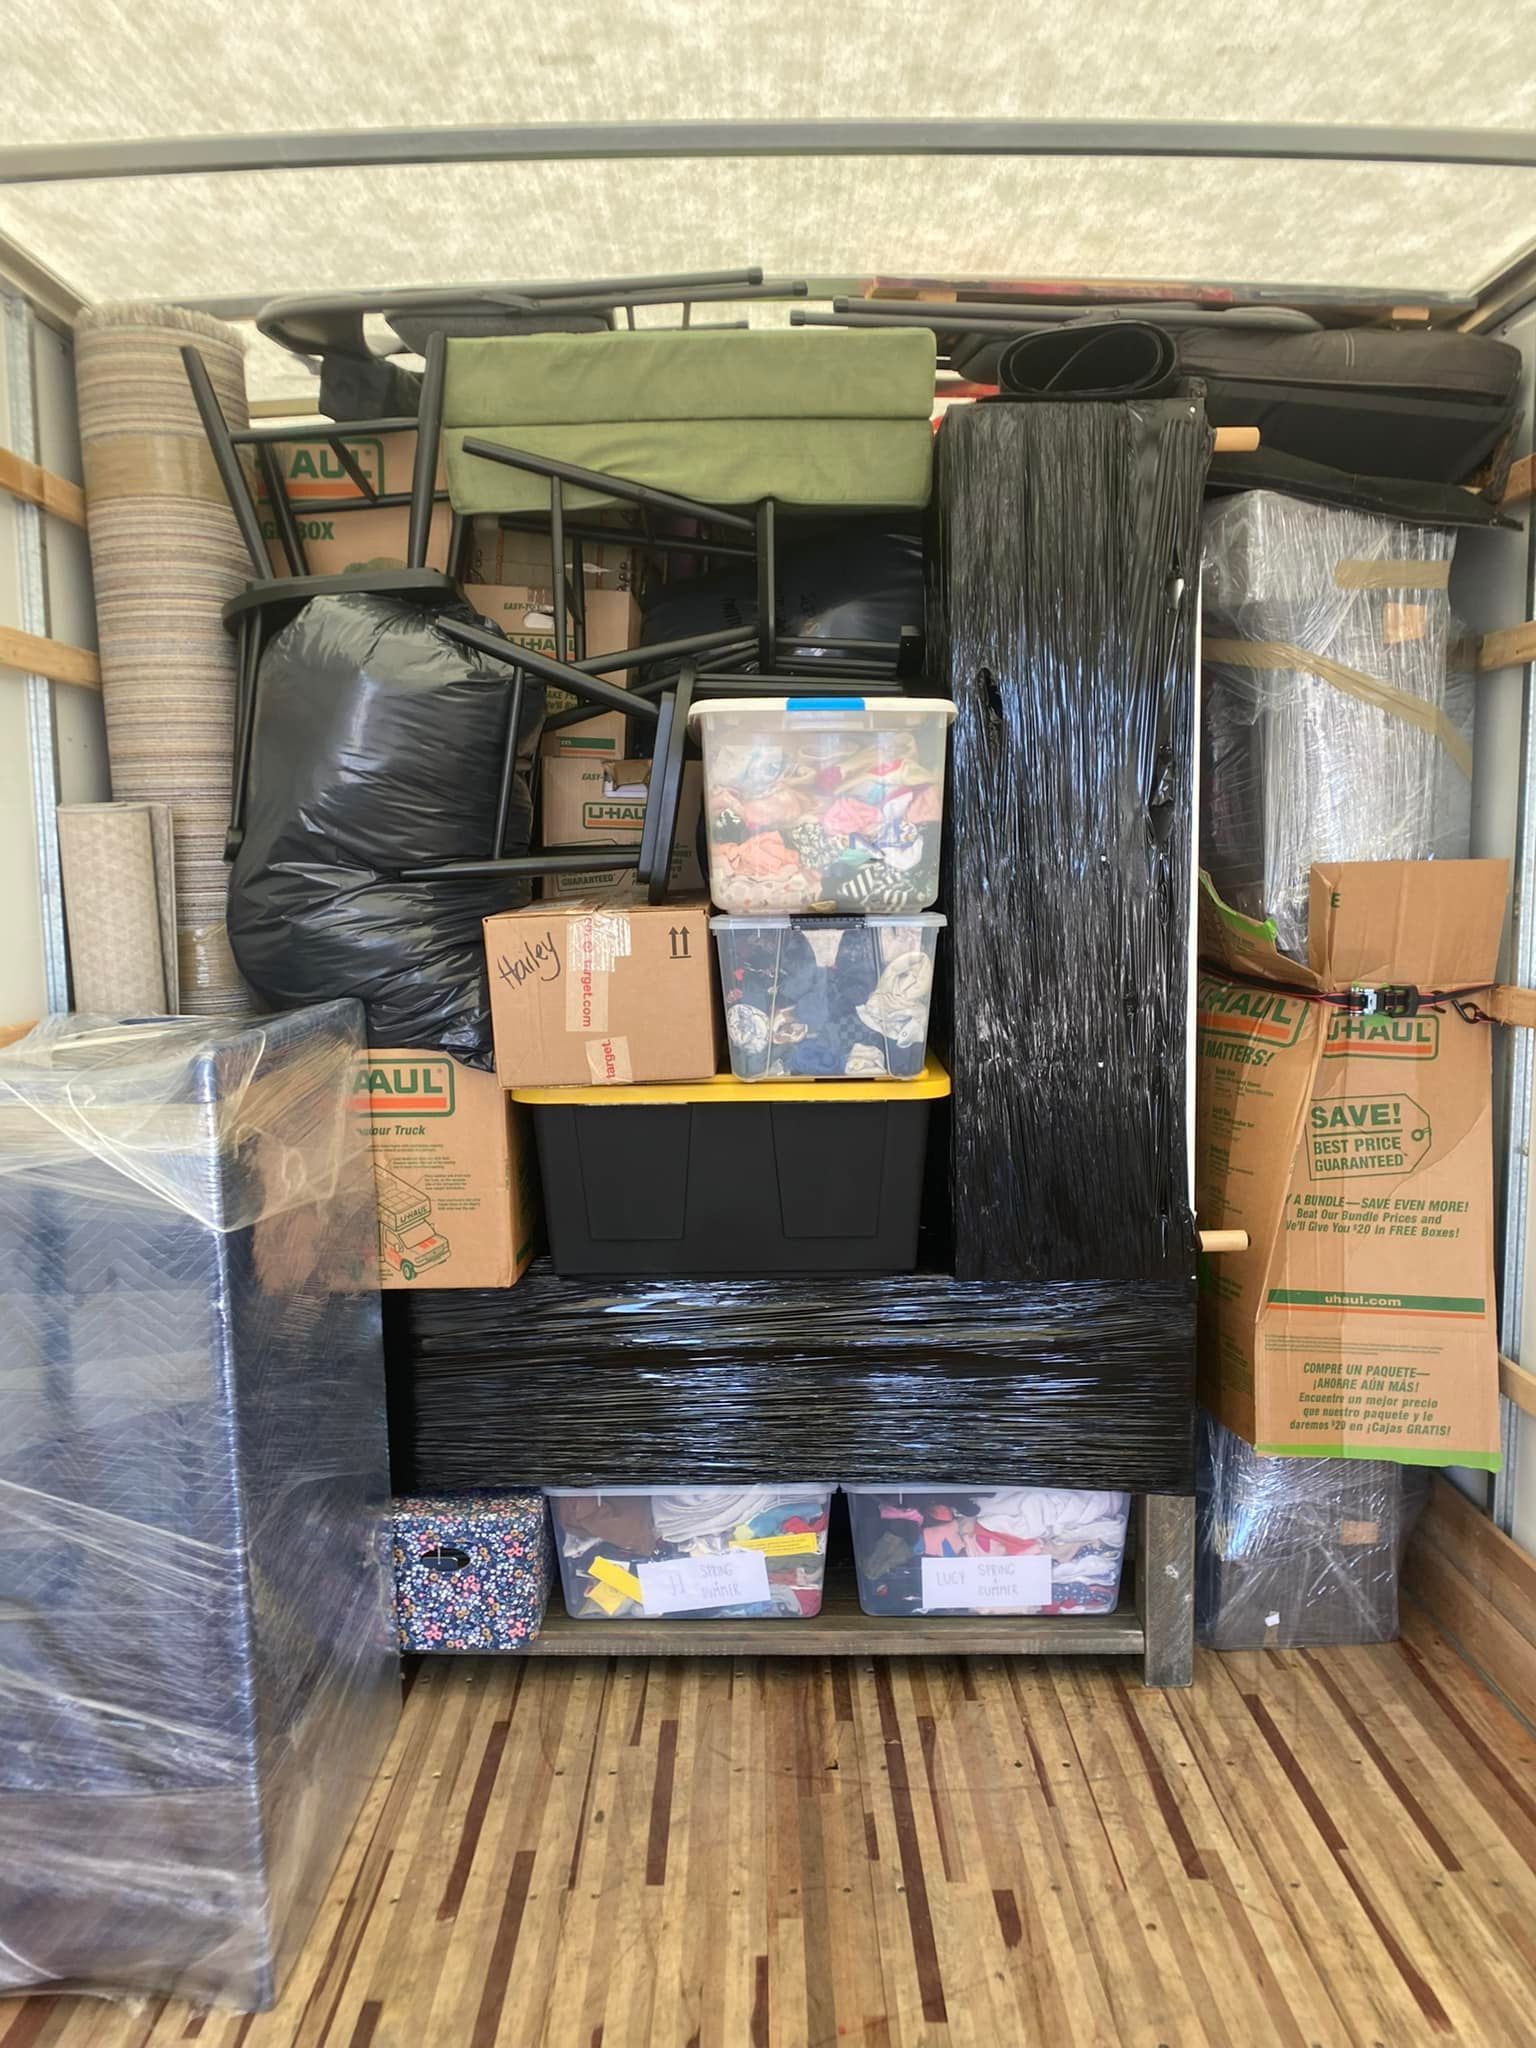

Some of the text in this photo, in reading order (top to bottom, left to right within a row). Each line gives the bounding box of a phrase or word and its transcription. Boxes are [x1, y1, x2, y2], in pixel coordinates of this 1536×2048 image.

[289, 450, 372, 479] AUL
[588, 807, 646, 820] U-HAU
[581, 959, 593, 1027] target.com
[1206, 1041, 1275, 1067] MATTERS!
[1311, 1103, 1401, 1129] SAVE!
[395, 1125, 426, 1136] Truck
[1314, 1137, 1401, 1155] BEST PRICE
[1394, 1199, 1425, 1211] EVEN
[1428, 1200, 1470, 1213] MORE!
[1296, 1208, 1442, 1225] Beat Our Bundle Prices and
[1308, 1220, 1328, 1232] Give
[1332, 1222, 1351, 1233] You
[1389, 1225, 1418, 1236] FREE
[1421, 1226, 1460, 1238] Boxes!
[1324, 1294, 1402, 1307] uhaul.com
[1304, 1362, 1343, 1375] COMPRE
[1346, 1364, 1363, 1375] UN
[1361, 1377, 1385, 1391] AÚN
[1388, 1379, 1420, 1393] MÁS!
[1299, 1392, 1344, 1404] Encuentre
[1366, 1396, 1399, 1407] mejor
[1402, 1397, 1438, 1408] precio
[1303, 1408, 1320, 1418] que
[1323, 1408, 1360, 1417] nuestro
[1363, 1410, 1409, 1421] paquete
[1290, 1419, 1329, 1430] daremos
[1349, 1422, 1363, 1431] en
[1407, 1424, 1452, 1436] GRATIS!
[936, 1570, 966, 1587] LUCY
